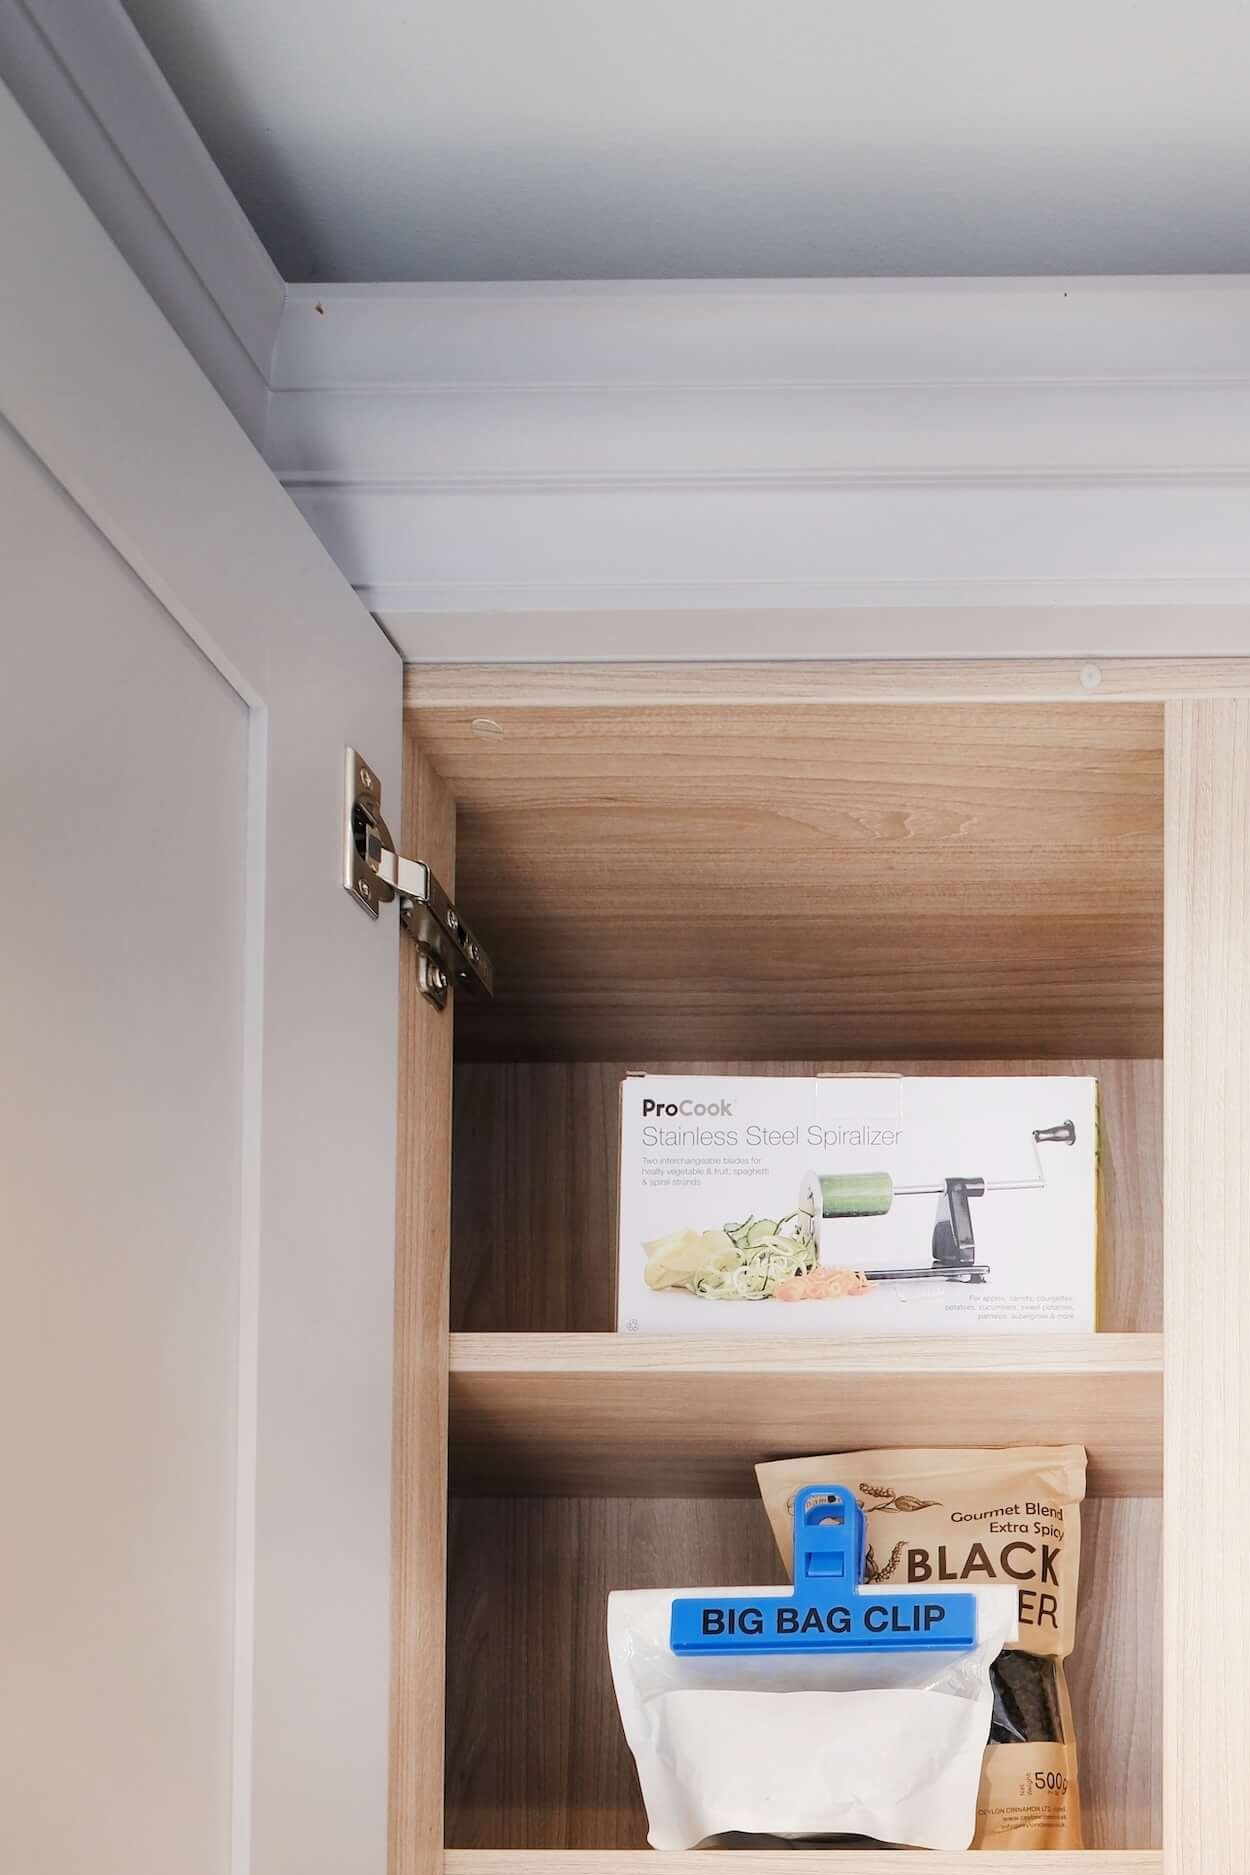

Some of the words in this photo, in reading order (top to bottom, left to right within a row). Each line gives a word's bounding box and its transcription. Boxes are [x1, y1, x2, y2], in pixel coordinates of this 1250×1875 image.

[642, 1098, 733, 1117] ProCook
[642, 1126, 738, 1146] Stainless
[745, 1125, 799, 1146] Steel
[807, 1124, 903, 1153] Spiralizer
[642, 1157, 657, 1165] Two
[751, 1156, 762, 1165] for
[951, 1504, 1020, 1523] Gourmet
[1025, 1502, 1064, 1521] Blend
[989, 1522, 1029, 1534] Extra
[1034, 1522, 1064, 1541] Spicy
[907, 1541, 1061, 1587] BLACK
[702, 1607, 763, 1635] BIG
[776, 1606, 851, 1634] BAG
[864, 1604, 946, 1632] CLIP
